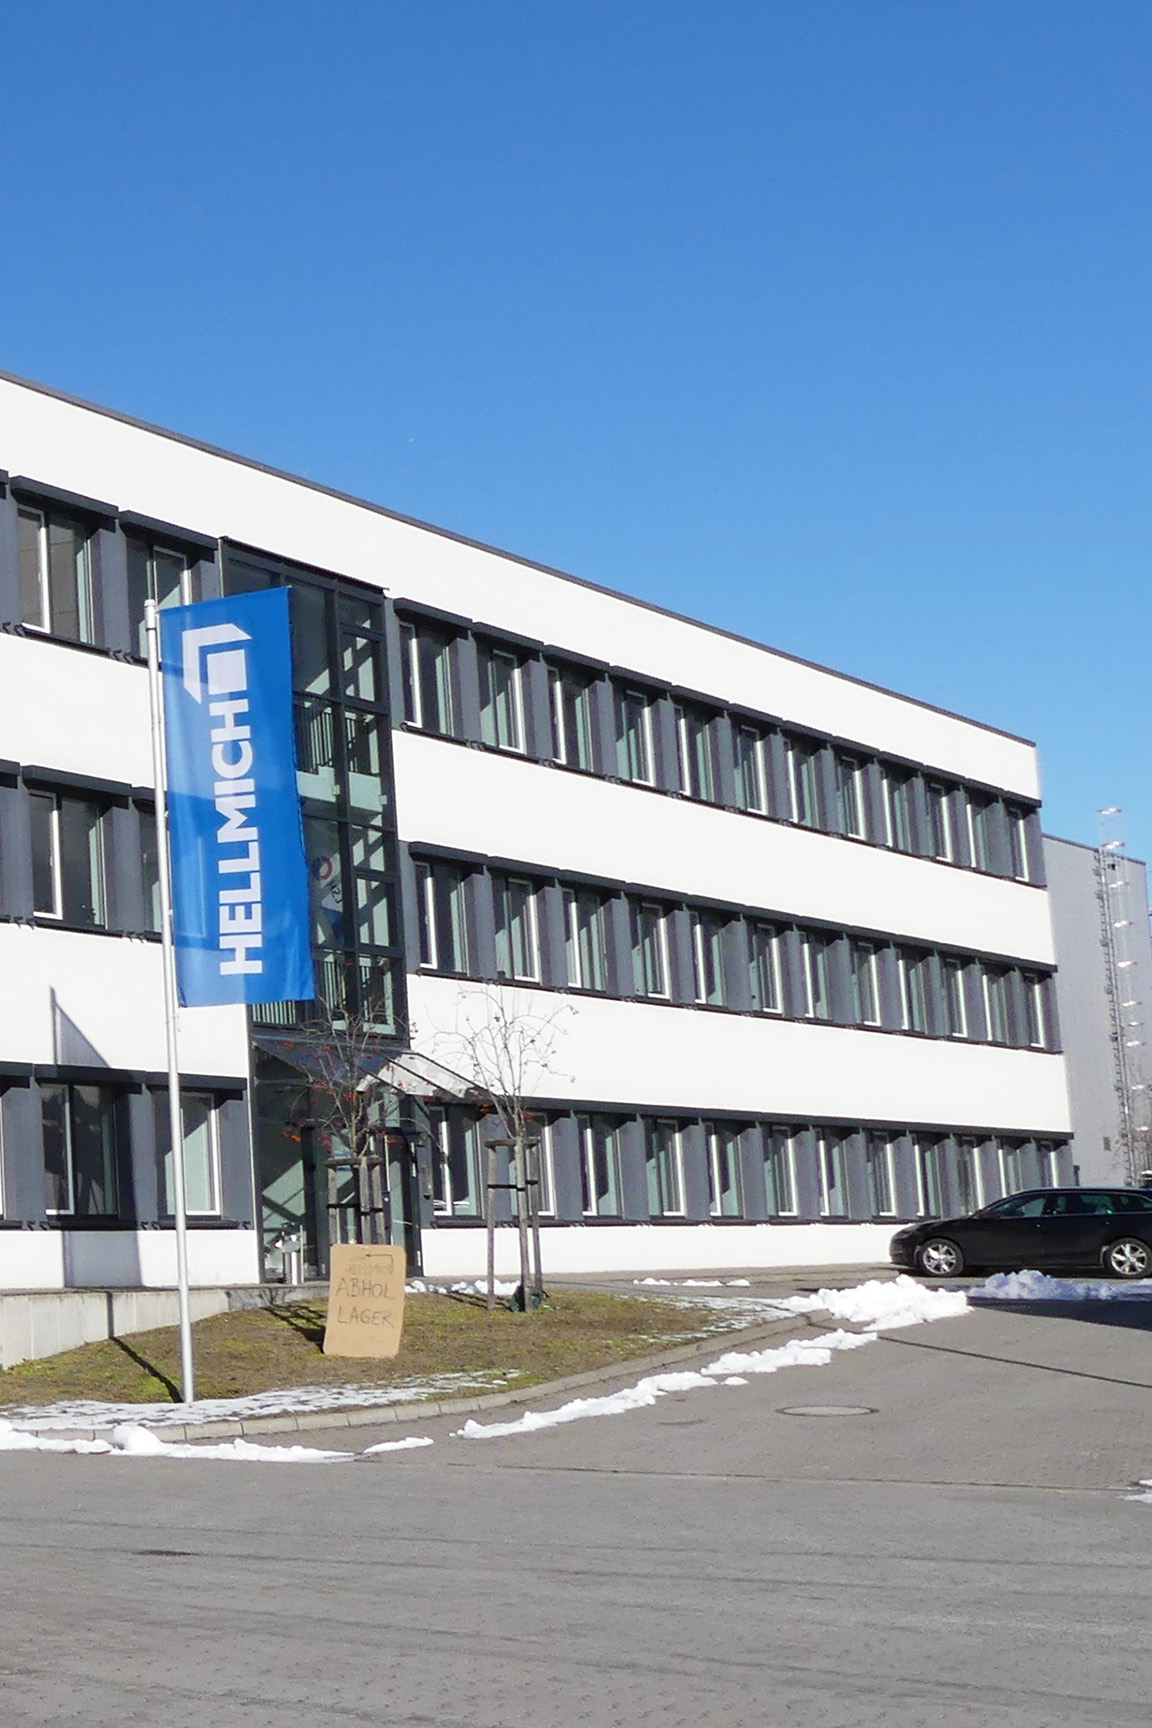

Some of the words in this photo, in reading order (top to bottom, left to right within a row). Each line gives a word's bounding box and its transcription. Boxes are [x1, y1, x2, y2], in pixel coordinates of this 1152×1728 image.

[209, 699, 263, 976] HELLMICH
[335, 1277, 395, 1300] ABHOL
[337, 1304, 396, 1329] LAGER
